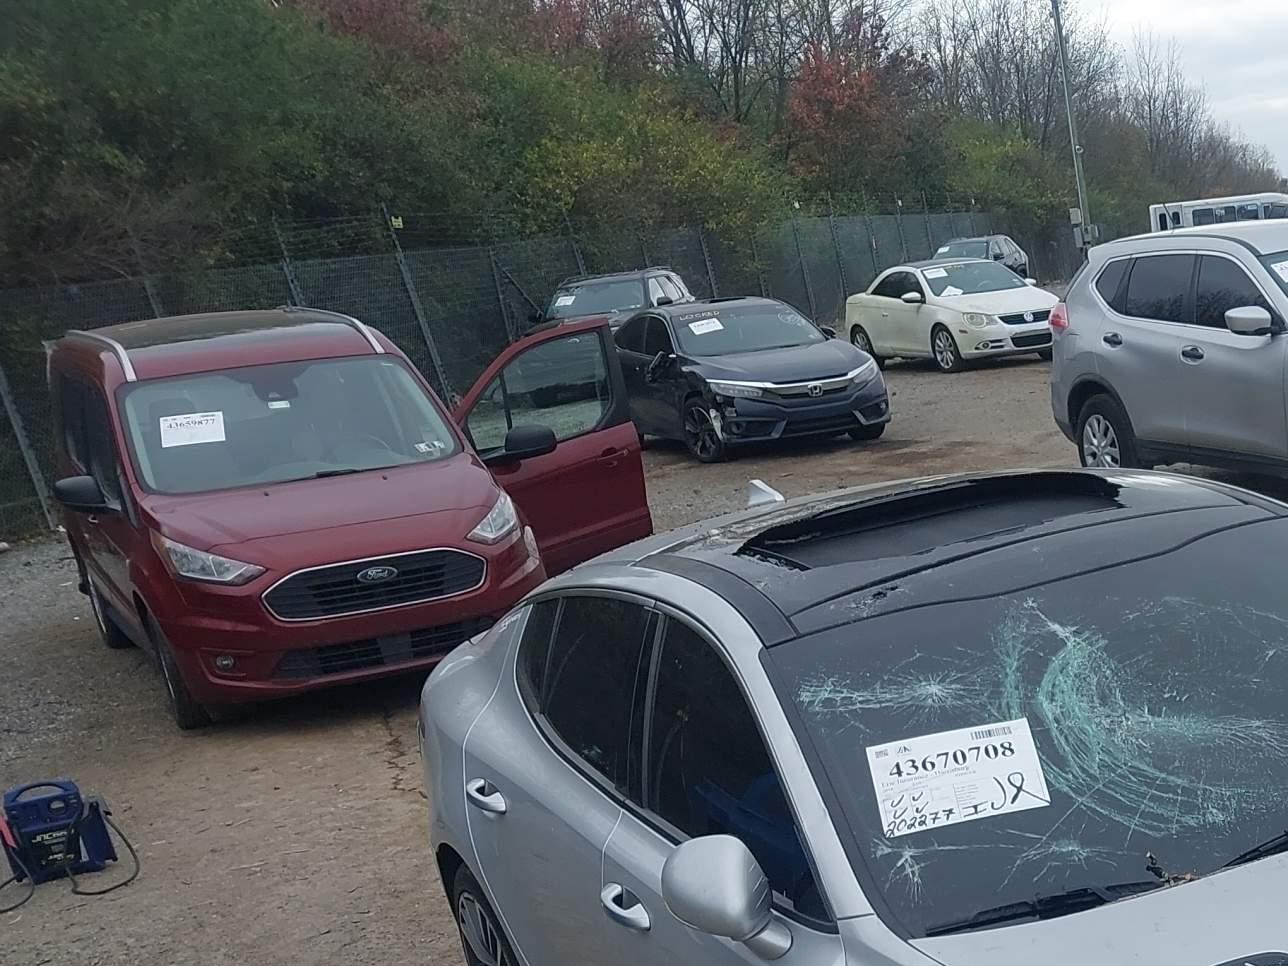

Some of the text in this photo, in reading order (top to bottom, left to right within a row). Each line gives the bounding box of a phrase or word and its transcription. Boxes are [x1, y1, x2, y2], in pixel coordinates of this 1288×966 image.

[679, 311, 720, 321] LOCKED
[366, 568, 389, 580] Ford
[889, 741, 1015, 778] 43670708
[885, 808, 956, 838] 202277
